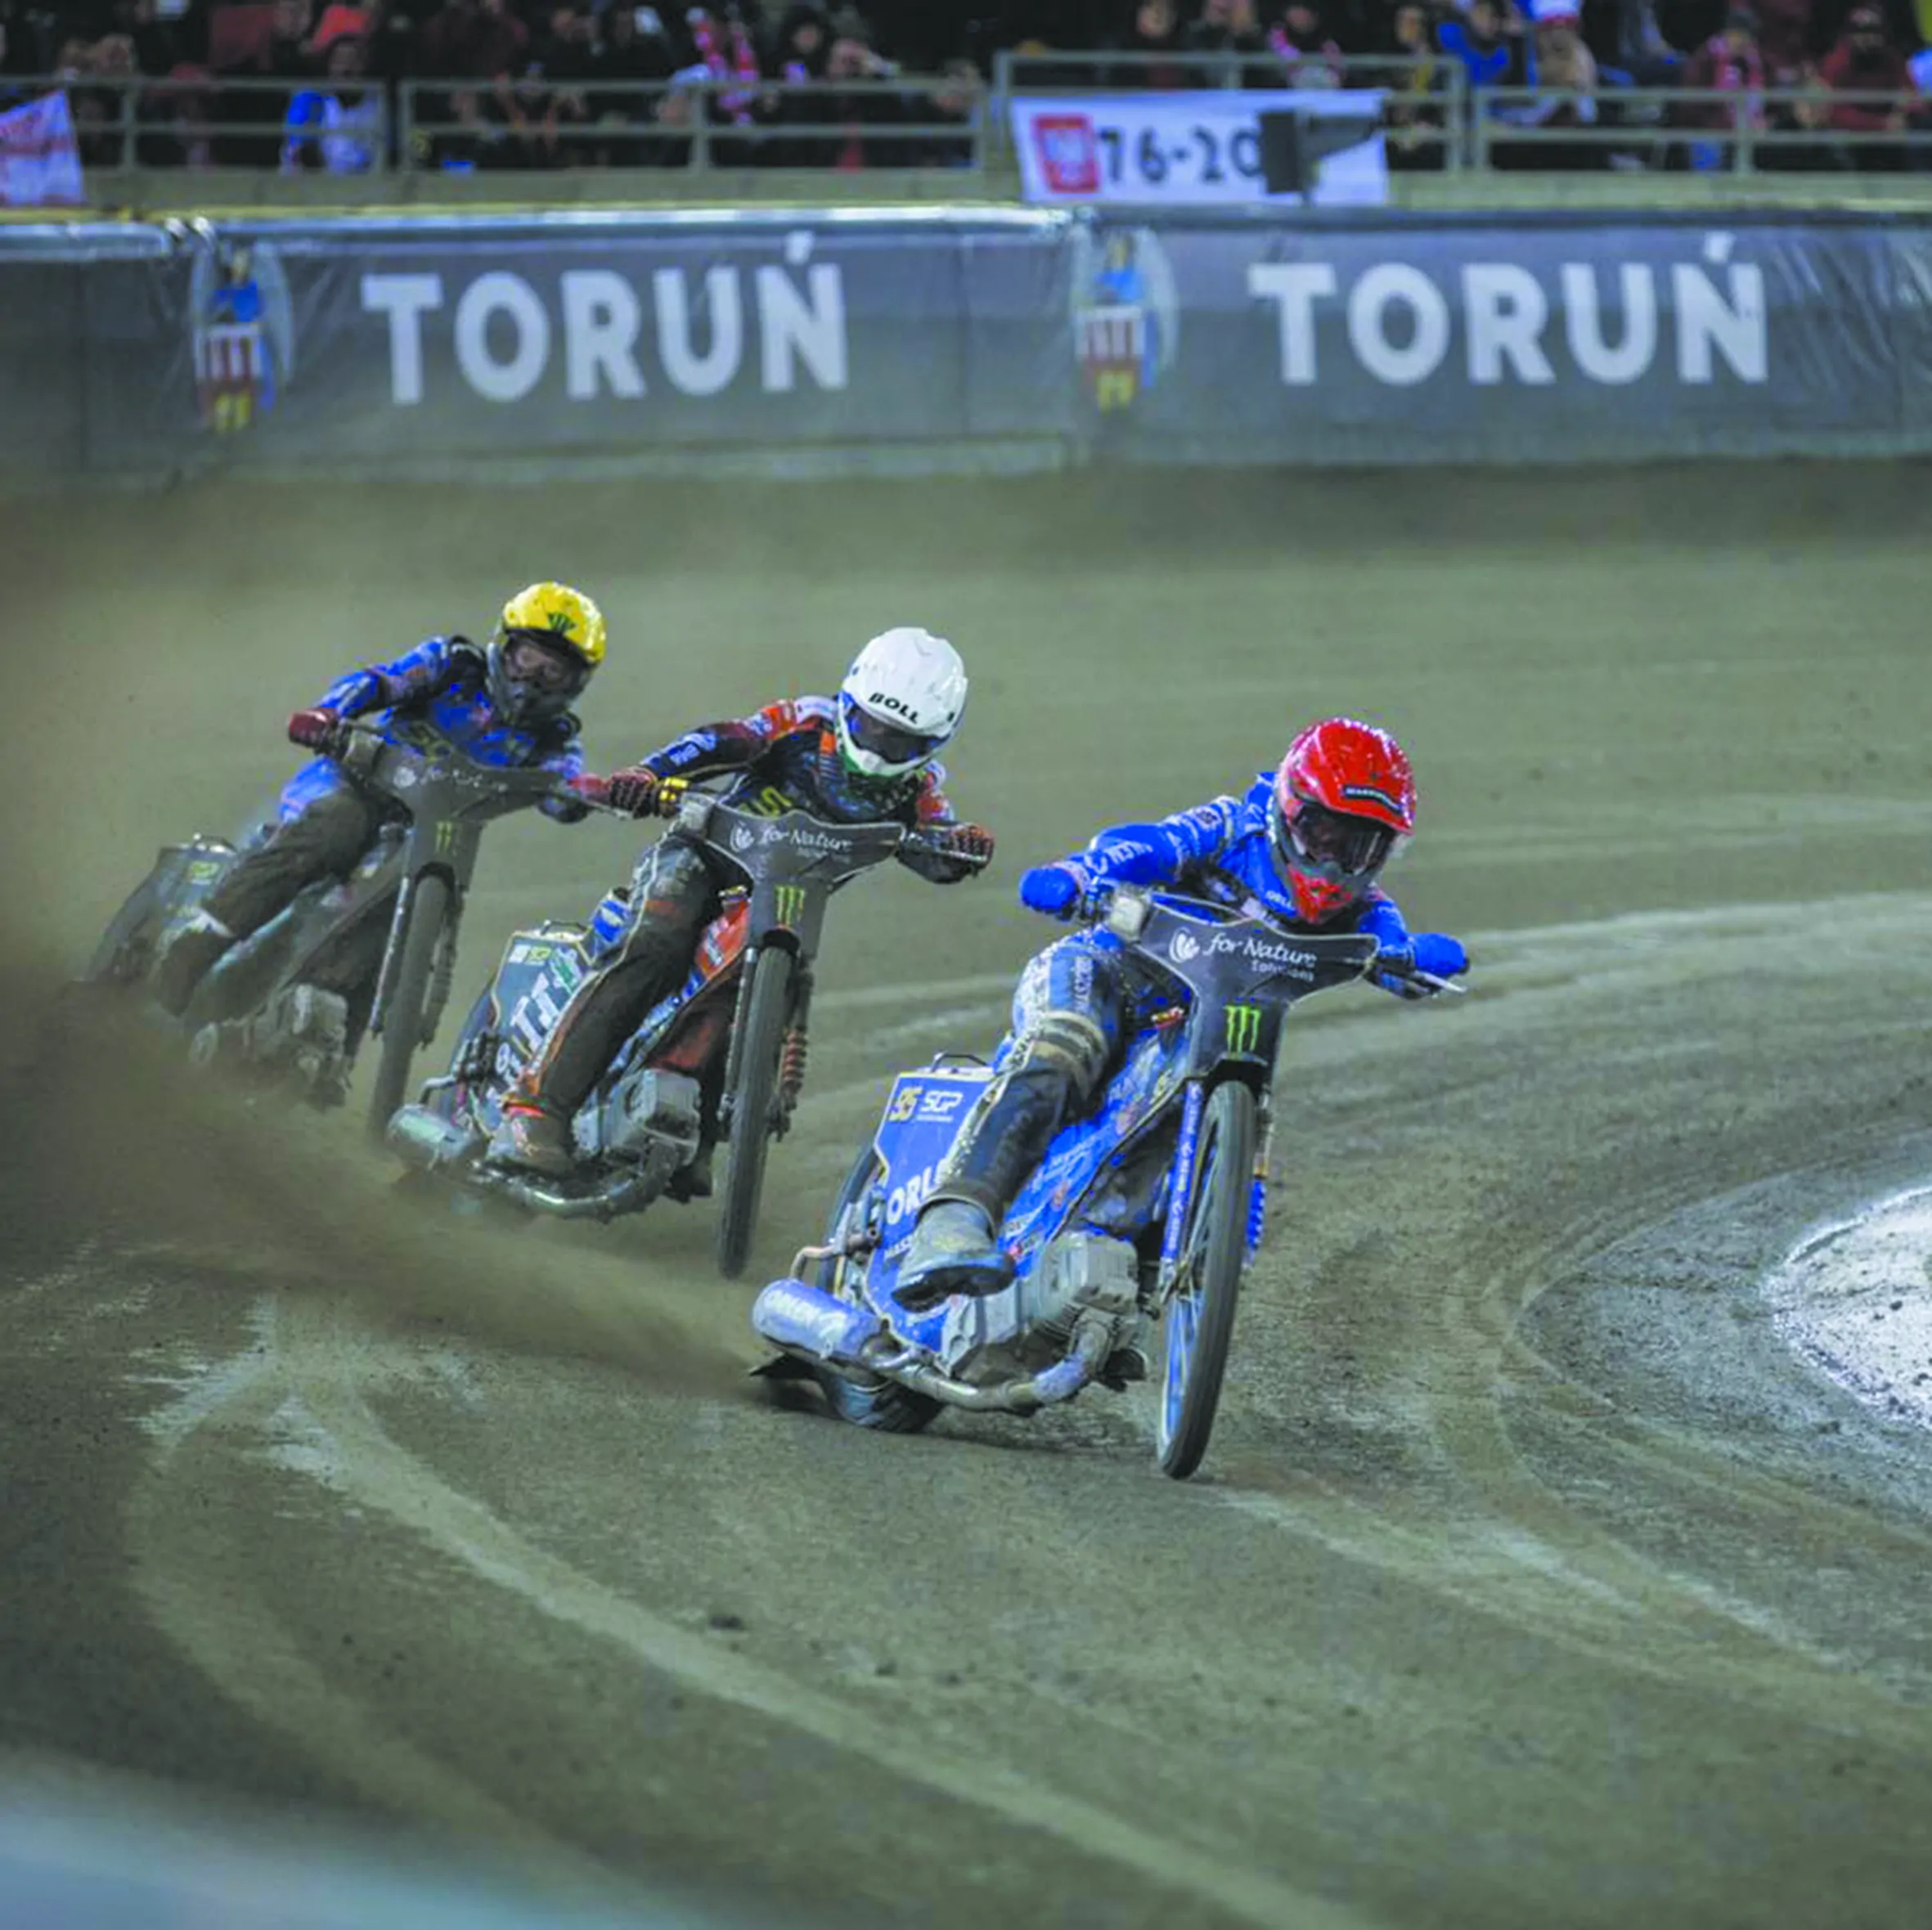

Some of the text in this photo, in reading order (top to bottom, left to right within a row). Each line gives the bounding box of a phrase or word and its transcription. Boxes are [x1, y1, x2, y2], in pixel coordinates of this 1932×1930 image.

[360, 231, 847, 404] TORUŃ
[1247, 232, 1768, 384] TORUŃ
[869, 692, 919, 725] BOLL
[1202, 931, 1318, 968] for Nature
